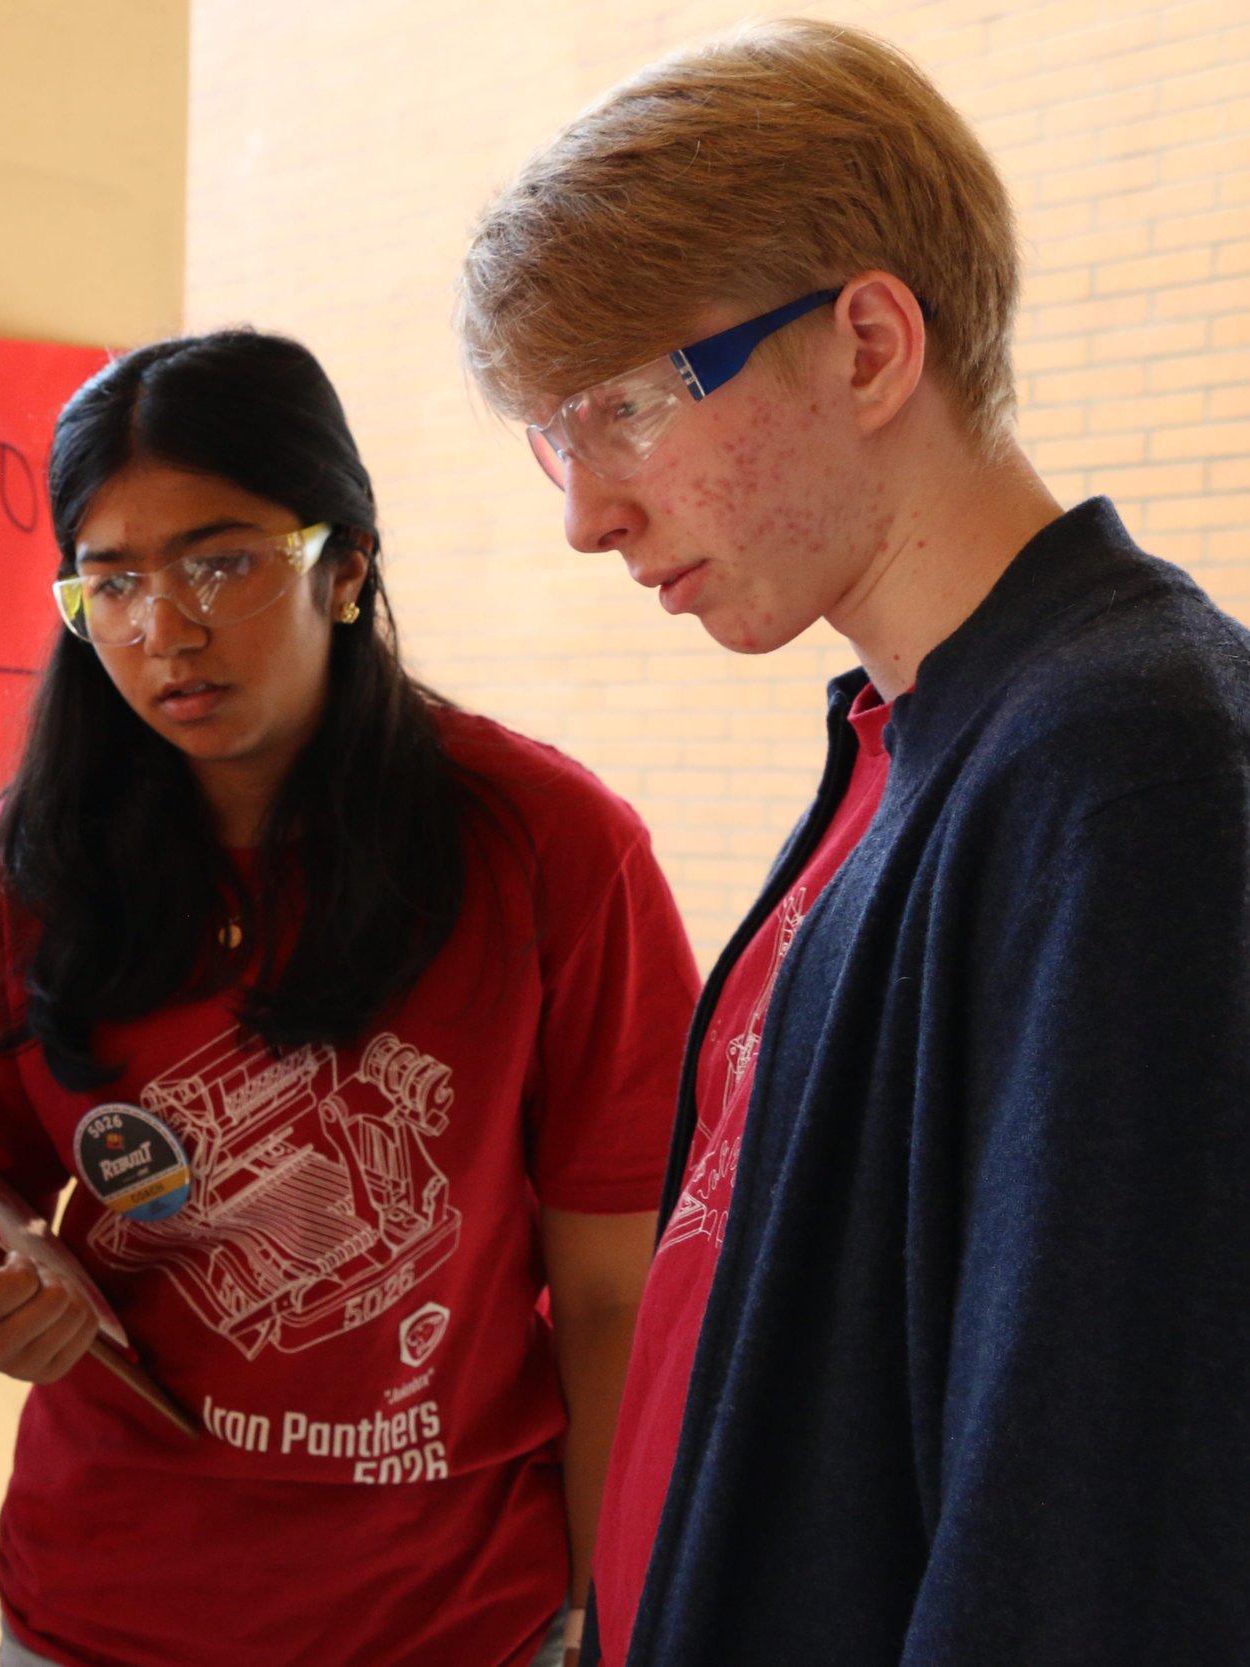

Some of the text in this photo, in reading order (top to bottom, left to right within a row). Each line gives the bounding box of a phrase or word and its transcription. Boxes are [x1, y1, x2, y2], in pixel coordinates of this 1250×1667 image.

[87, 1114, 123, 1139] 5026
[343, 1260, 415, 1330] 5026
[203, 1395, 441, 1458] Iron Panthers
